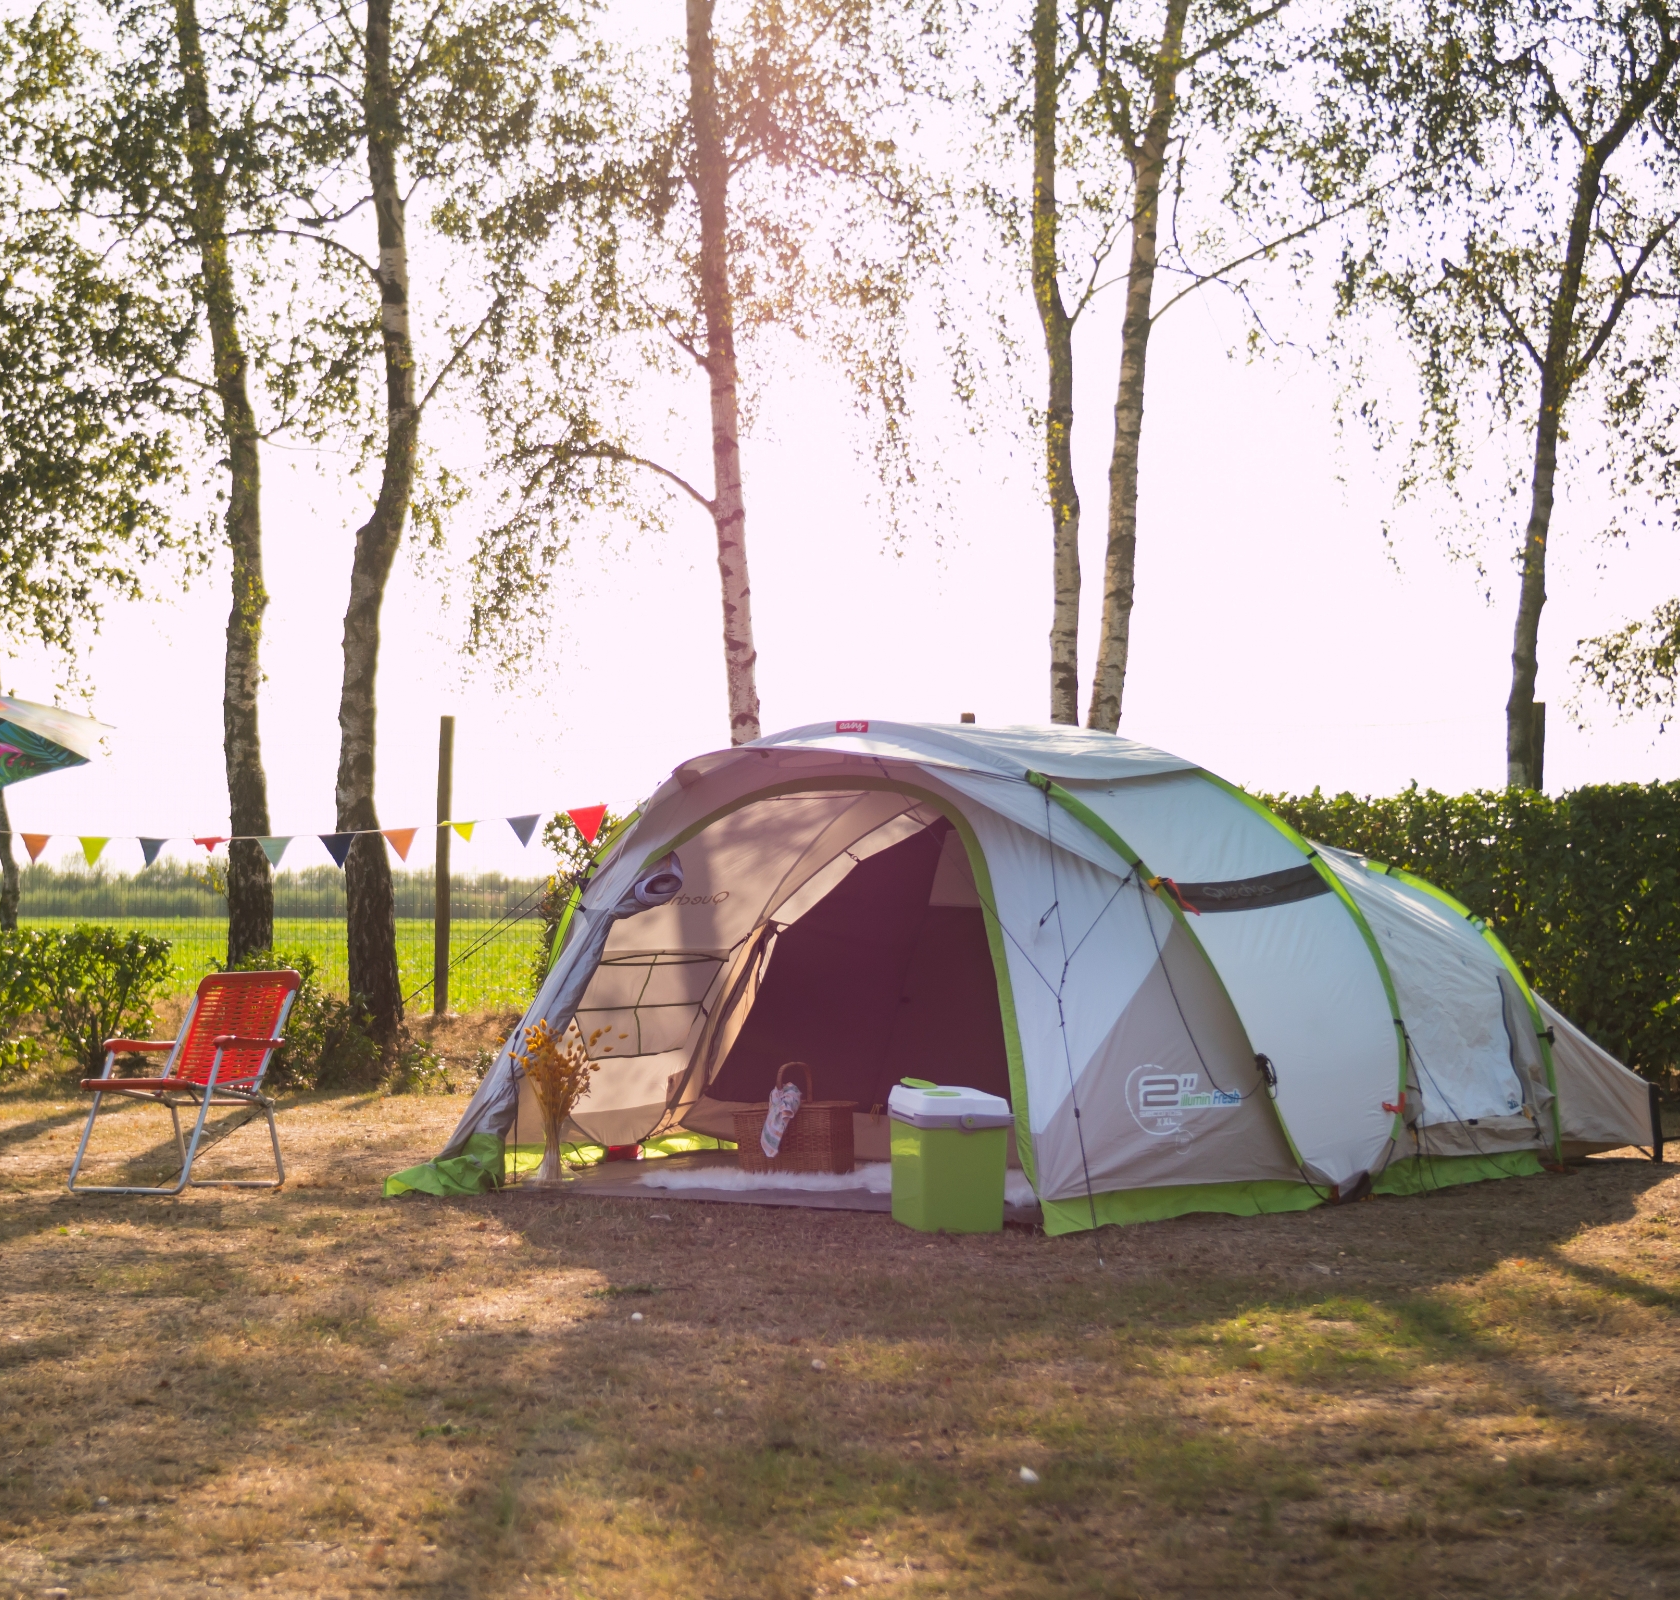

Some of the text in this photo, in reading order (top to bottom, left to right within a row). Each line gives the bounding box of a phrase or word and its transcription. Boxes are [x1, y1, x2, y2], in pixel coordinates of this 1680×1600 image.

[1180, 1089, 1240, 1107] illumin Fresh
[1156, 1117, 1177, 1127] XXL
